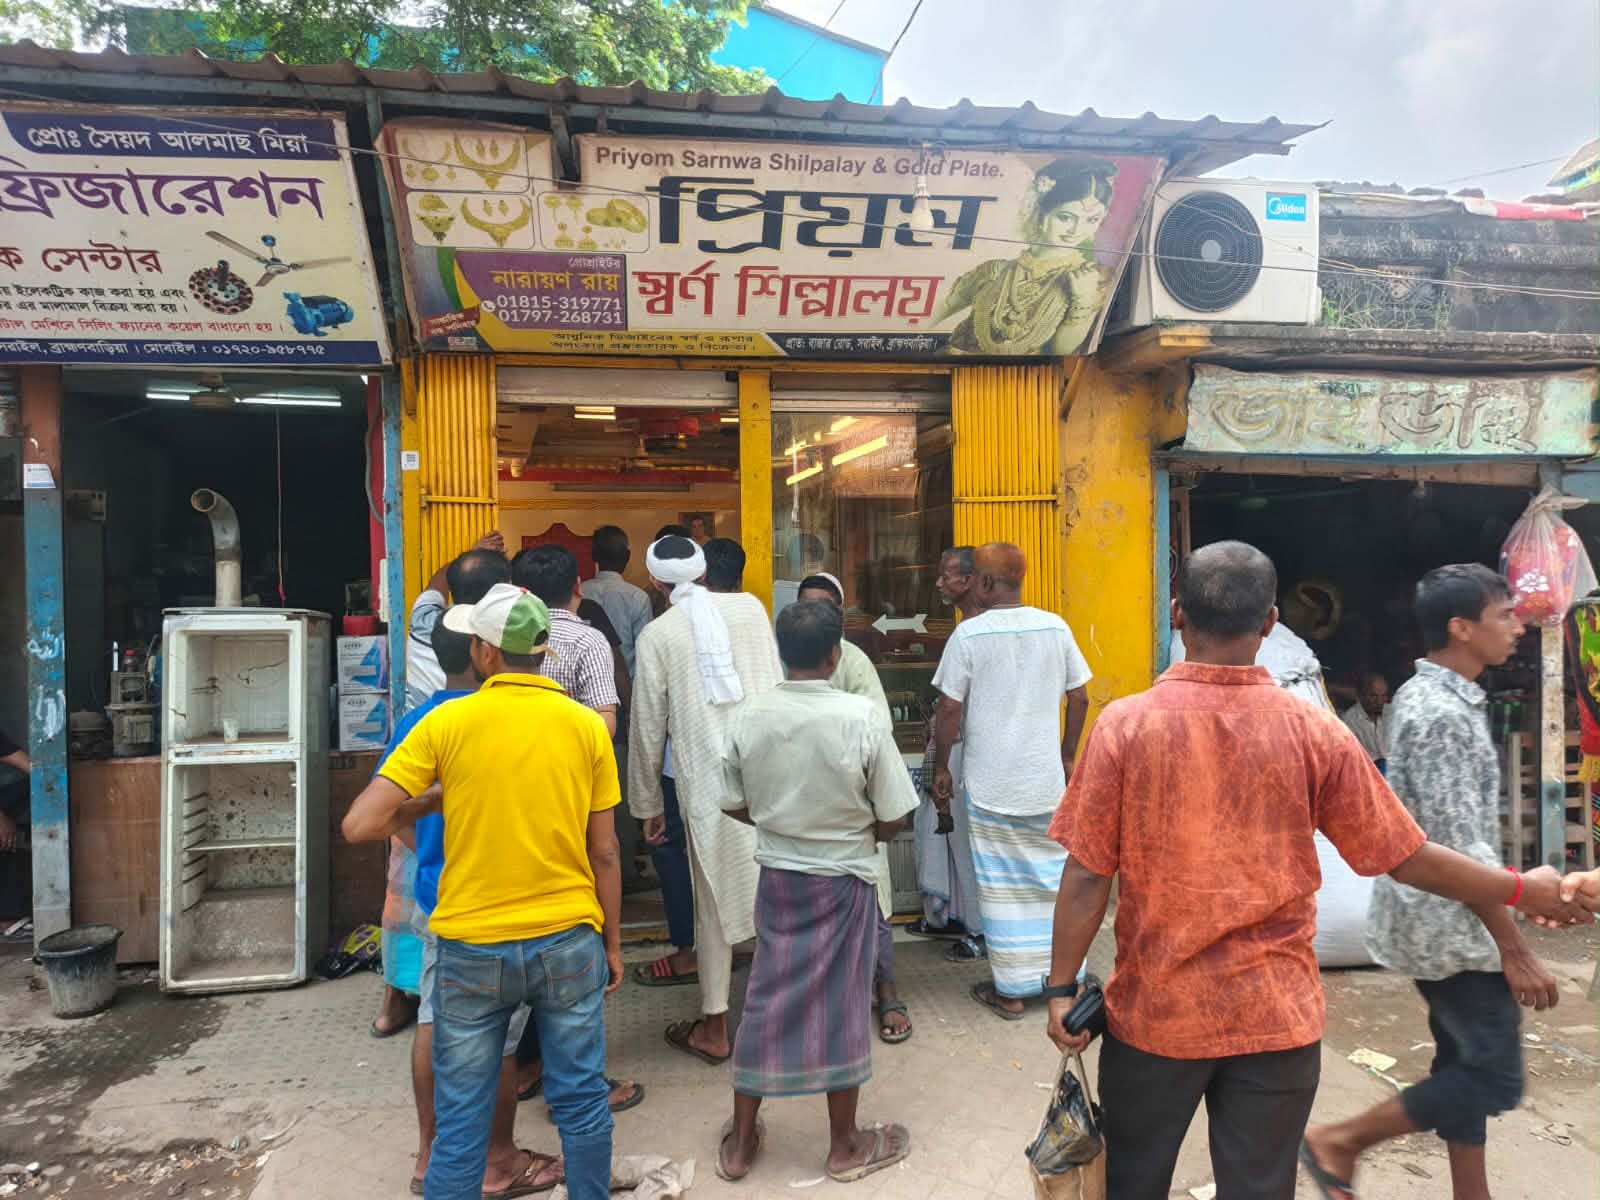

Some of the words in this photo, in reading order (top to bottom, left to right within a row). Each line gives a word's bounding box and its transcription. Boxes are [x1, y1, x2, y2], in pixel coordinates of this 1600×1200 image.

[27, 126, 81, 148] প্রোঃ
[80, 123, 152, 150] সৈয়দ
[158, 131, 256, 154] আলমাছ
[257, 127, 309, 153] মিয়া
[596, 145, 674, 170] Priyom
[681, 150, 761, 170] Sarnwa
[769, 152, 866, 177] Shilpalay
[872, 156, 887, 174] &
[895, 157, 945, 176] Gold
[951, 159, 1005, 178] Plate.
[0, 155, 325, 219] ফ্রিজারেশন
[645, 176, 998, 258] প্রিয়ম
[1268, 197, 1305, 215] Midea
[41, 239, 163, 273] সেন্টার
[108, 287, 134, 298] করা
[138, 288, 155, 298] হয়
[160, 288, 186, 298] এবং
[489, 269, 573, 291] নারায়ণ
[578, 272, 621, 292] রায়
[632, 259, 720, 316] স্বর্ণ
[735, 265, 944, 324] শিল্পালয়
[131, 302, 157, 313] করা
[160, 303, 178, 313] হয়
[497, 294, 623, 310] 01815-319771
[499, 309, 624, 325] 01797-268731
